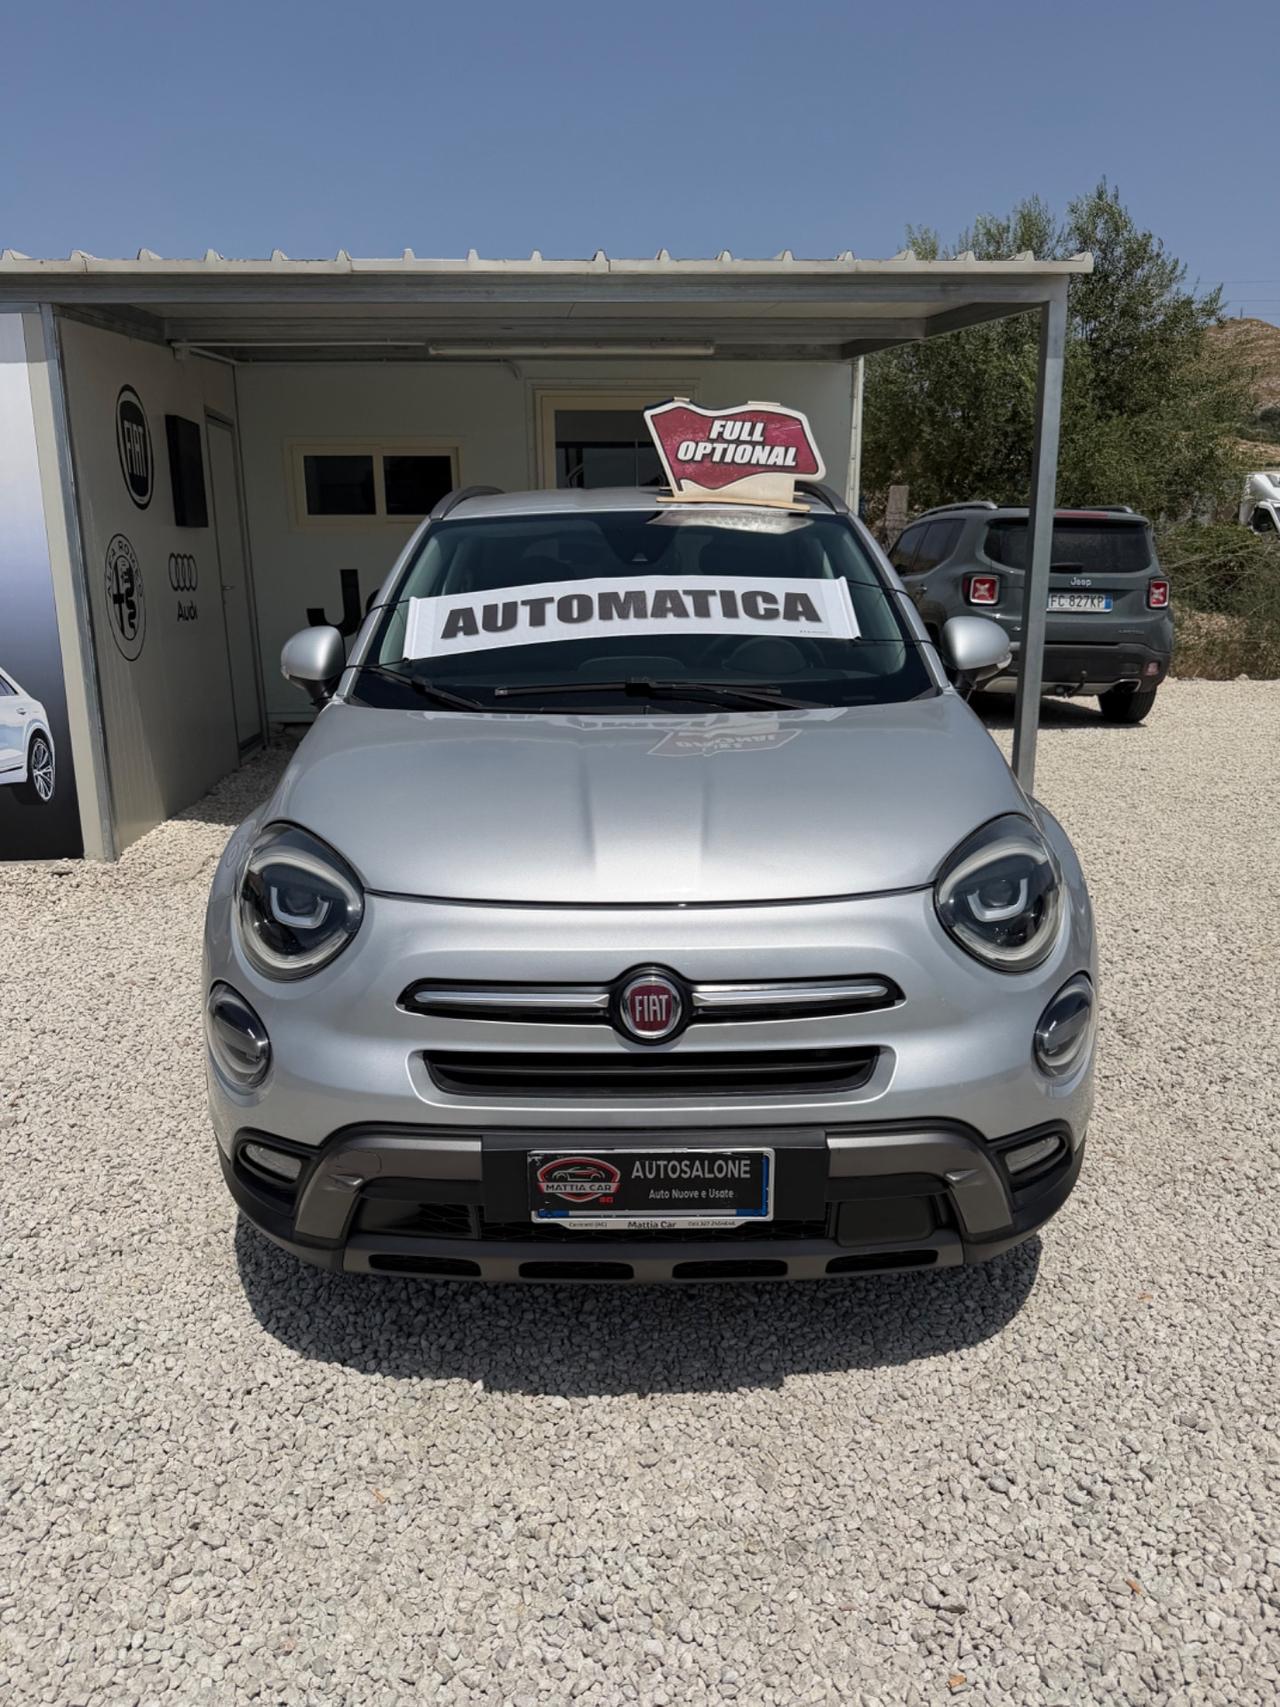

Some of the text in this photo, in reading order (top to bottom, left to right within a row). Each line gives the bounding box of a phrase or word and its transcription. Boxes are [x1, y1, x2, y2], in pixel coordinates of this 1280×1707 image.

[709, 420, 764, 442] FULL
[123, 420, 147, 478] FIAT
[677, 440, 797, 467] OPTIONAL
[1070, 577, 1092, 587] Jeep
[1050, 594, 1065, 607] FC
[177, 600, 198, 622] Audi
[440, 589, 822, 639] AUTOMATICA
[634, 995, 669, 1022] FIAT
[631, 1160, 751, 1179] AUTOSALONE
[545, 1184, 611, 1192] MATTIA CAR
[649, 1188, 734, 1199] Auto Nuove e Usate
[627, 1221, 659, 1229] Mattia
